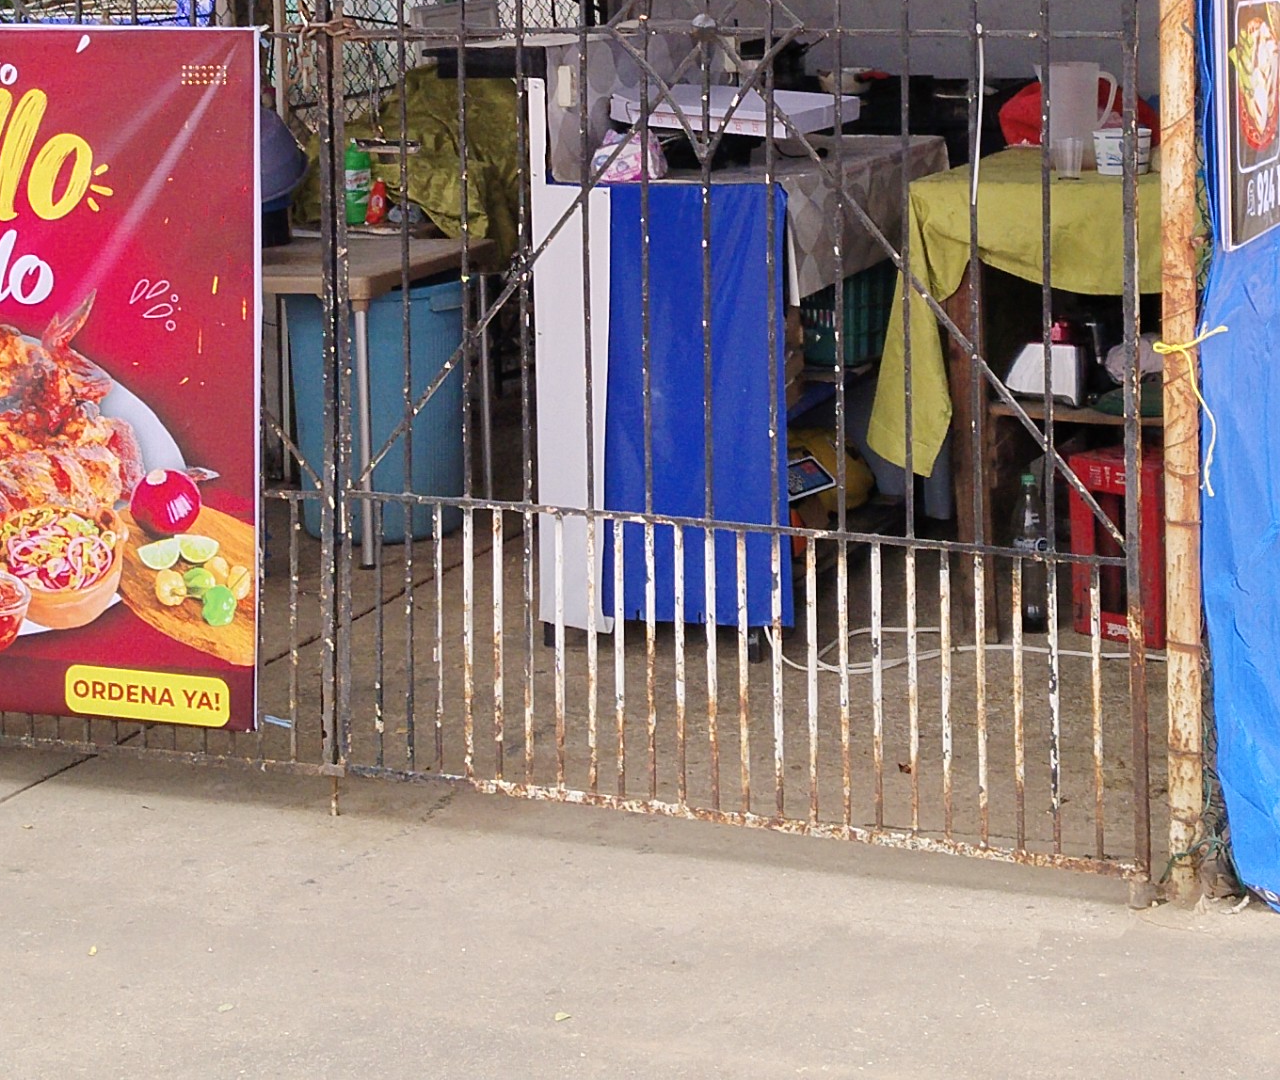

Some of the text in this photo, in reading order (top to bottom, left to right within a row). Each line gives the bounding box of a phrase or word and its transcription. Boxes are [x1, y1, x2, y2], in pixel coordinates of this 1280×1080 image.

[1256, 170, 1276, 217] 924
[73, 679, 221, 712] ORDENA YA!
